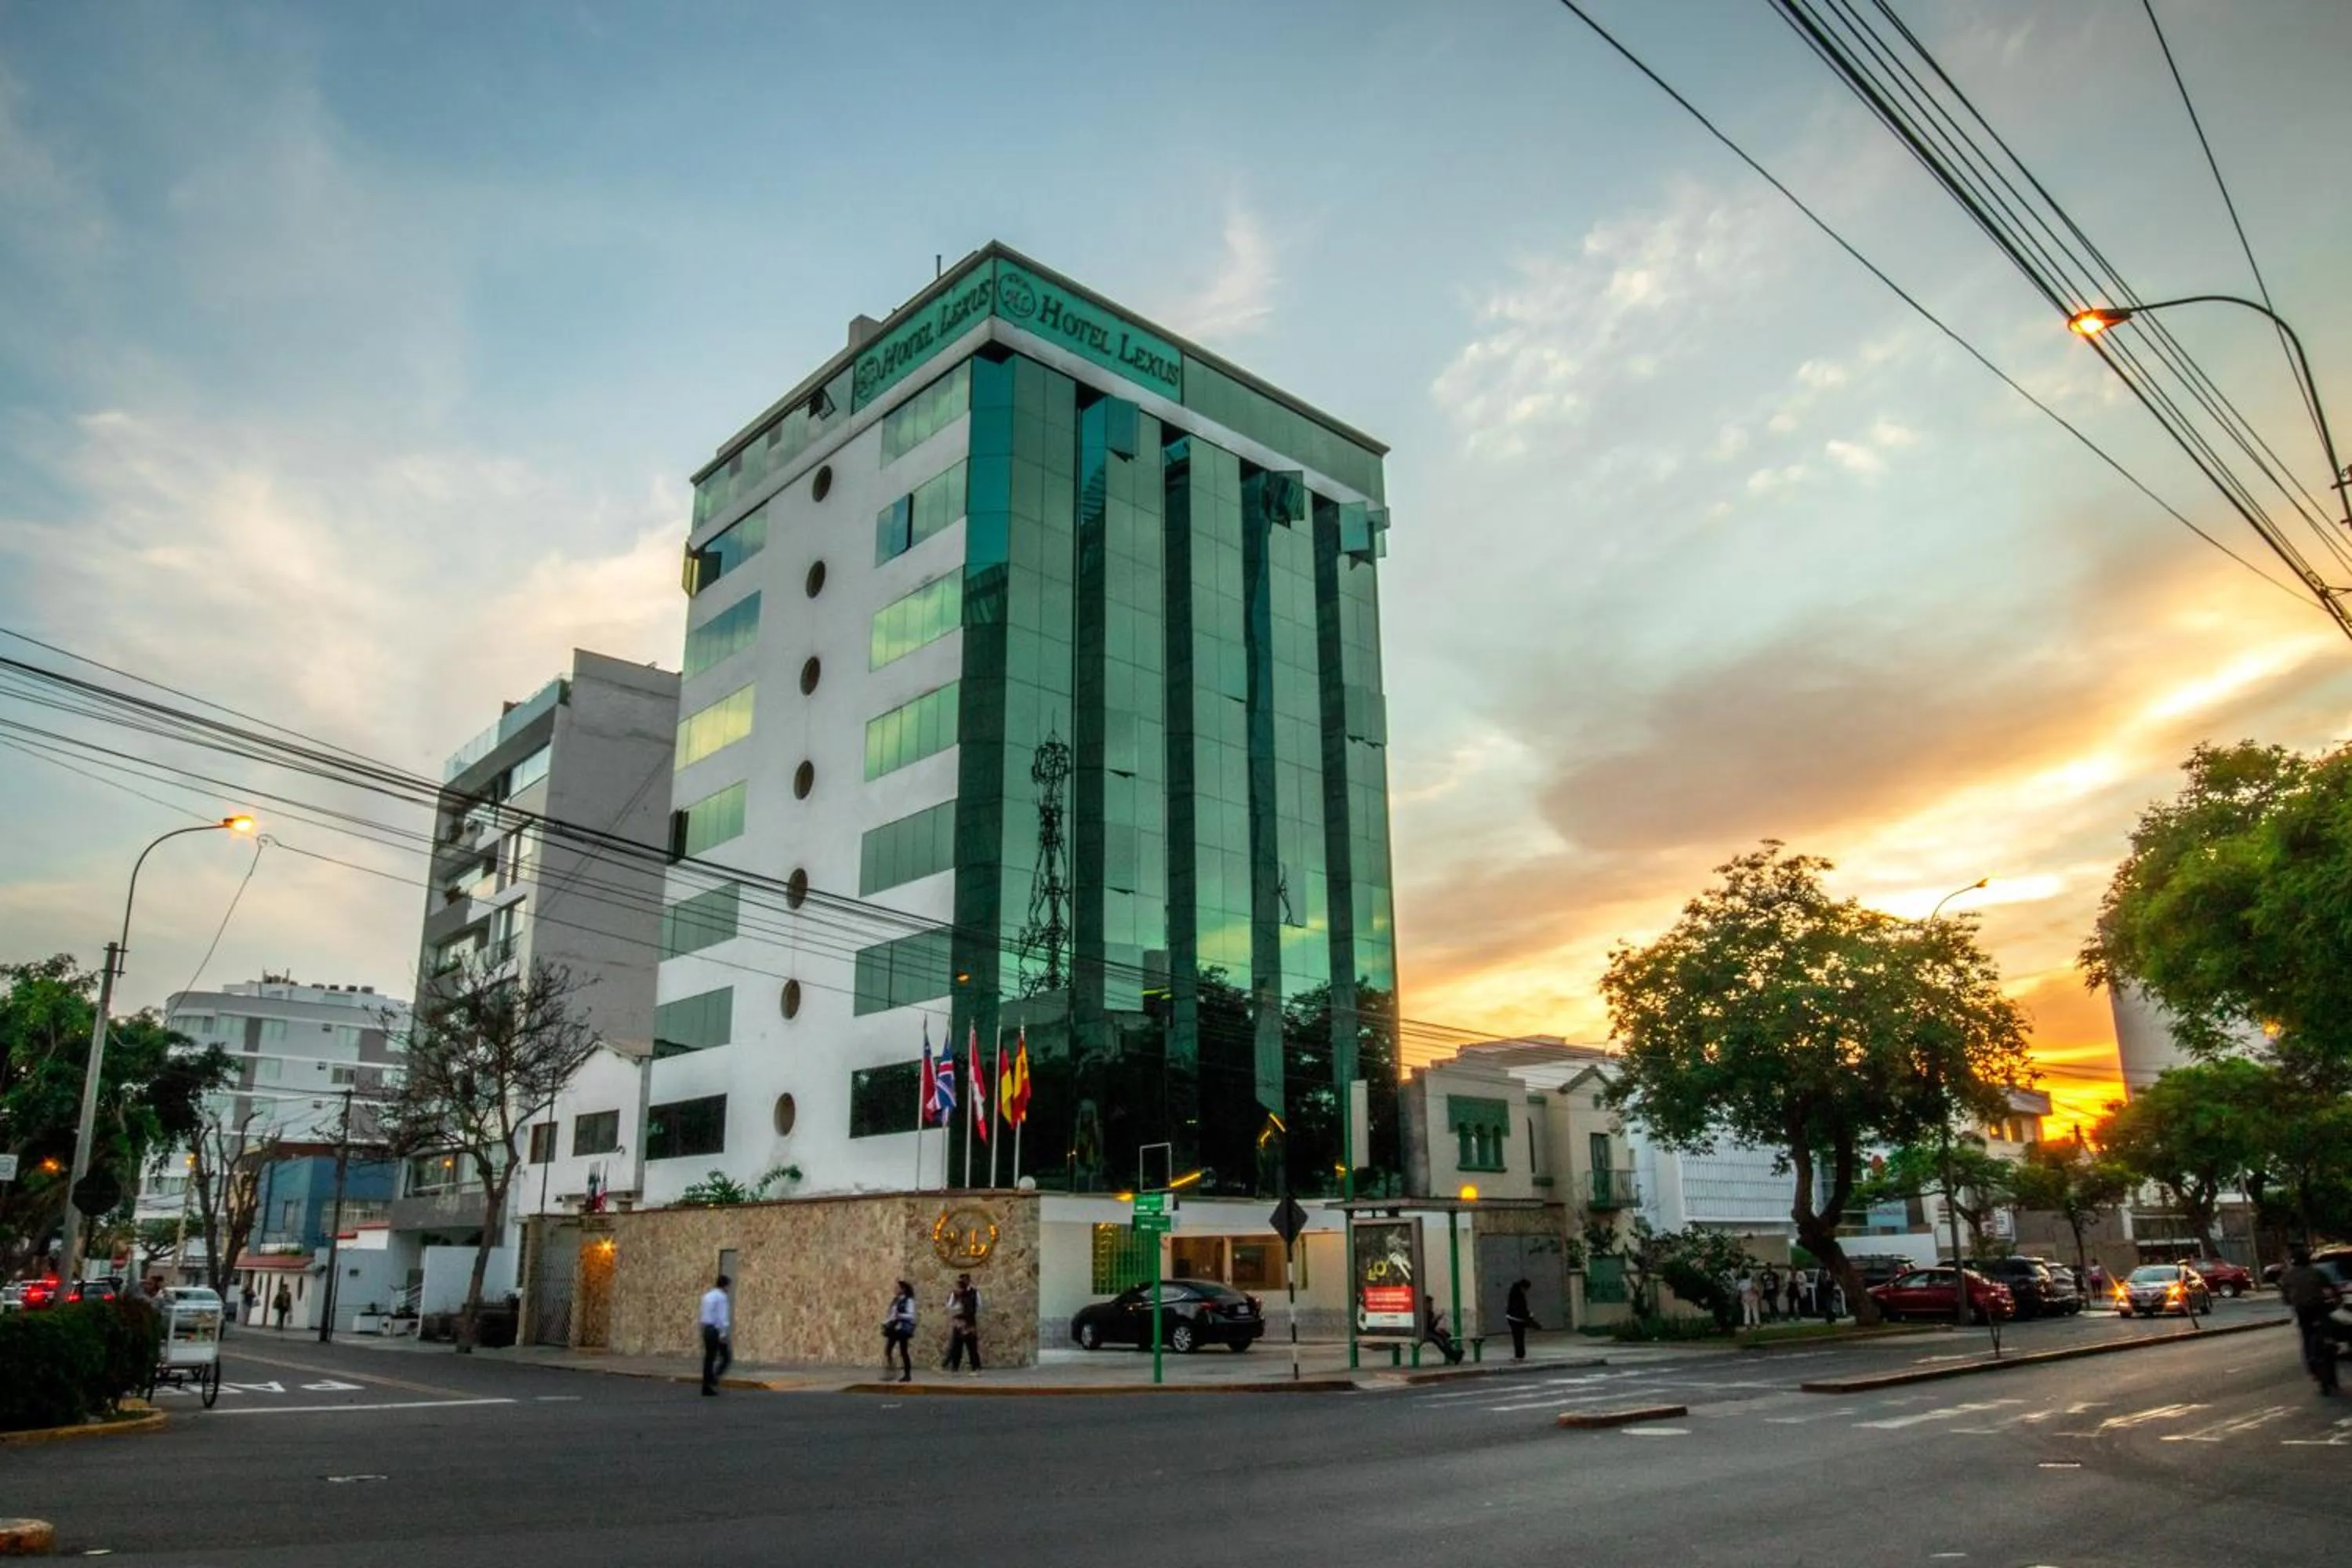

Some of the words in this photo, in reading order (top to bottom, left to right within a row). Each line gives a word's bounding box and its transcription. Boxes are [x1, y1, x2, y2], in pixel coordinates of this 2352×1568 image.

[880, 321, 934, 379] HOTEL
[938, 278, 991, 337] LEXUS
[1038, 294, 1111, 354] HOTEL
[1119, 332, 1179, 386] LEXUS
